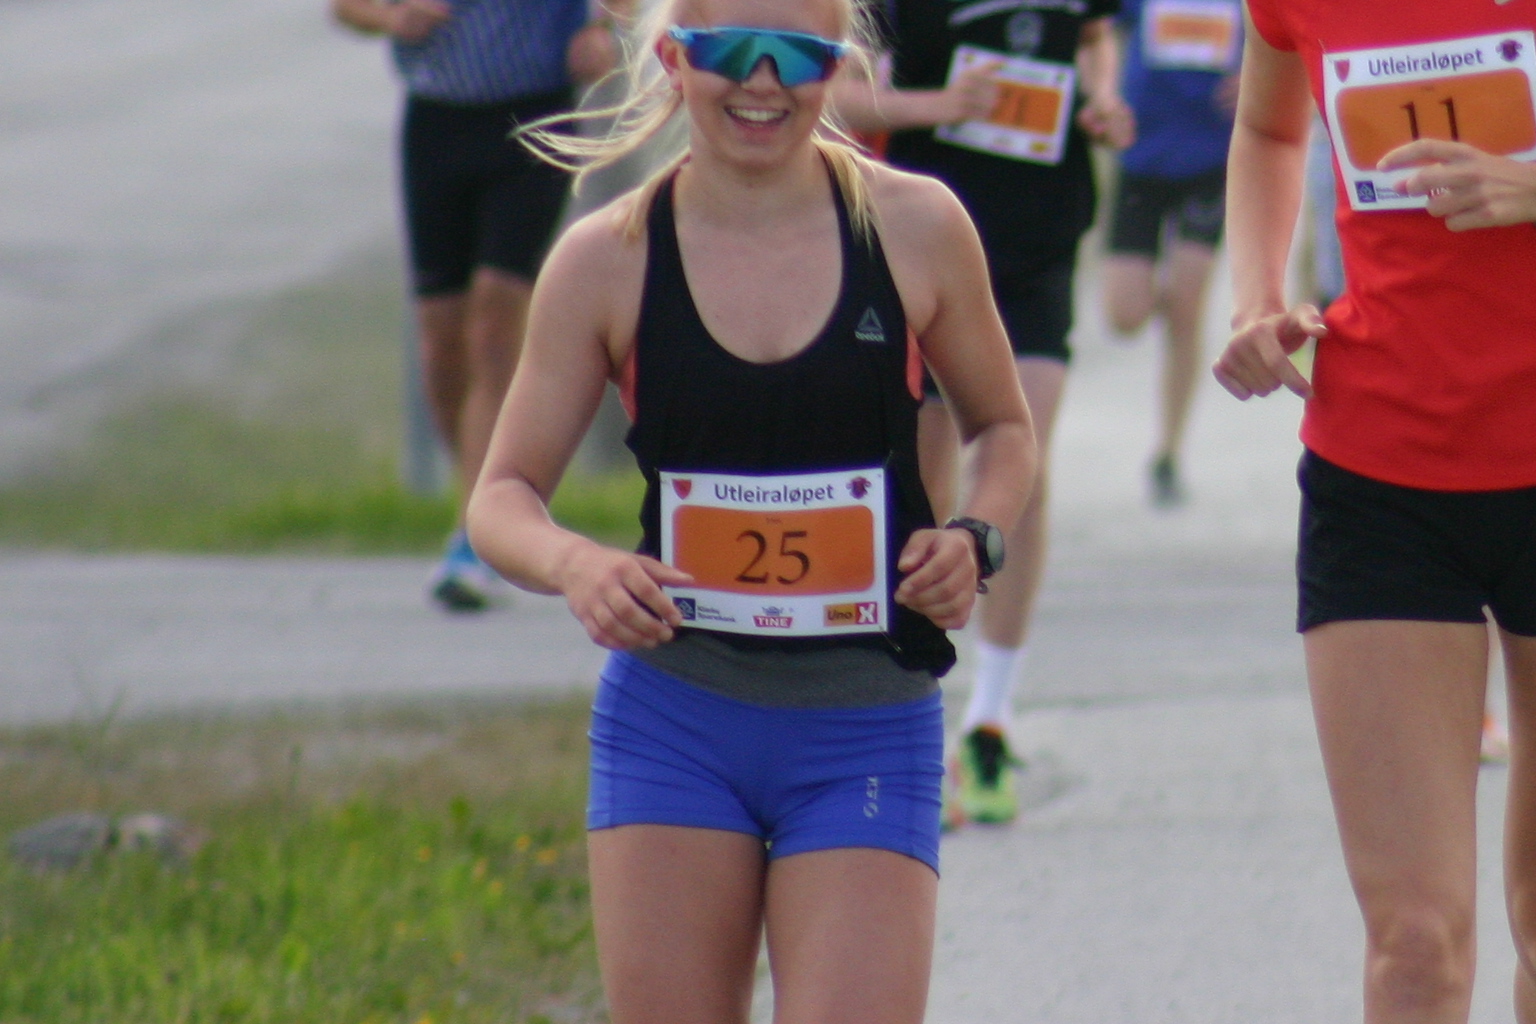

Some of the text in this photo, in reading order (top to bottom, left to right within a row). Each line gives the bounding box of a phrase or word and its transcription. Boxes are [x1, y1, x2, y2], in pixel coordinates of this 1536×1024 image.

[1368, 48, 1484, 77] Utleiraløpet
[1400, 96, 1459, 142] 11
[714, 483, 834, 505] Utleiraløpet
[735, 529, 811, 585] 25
[757, 616, 789, 627] TINE
[827, 609, 854, 621] Uno
